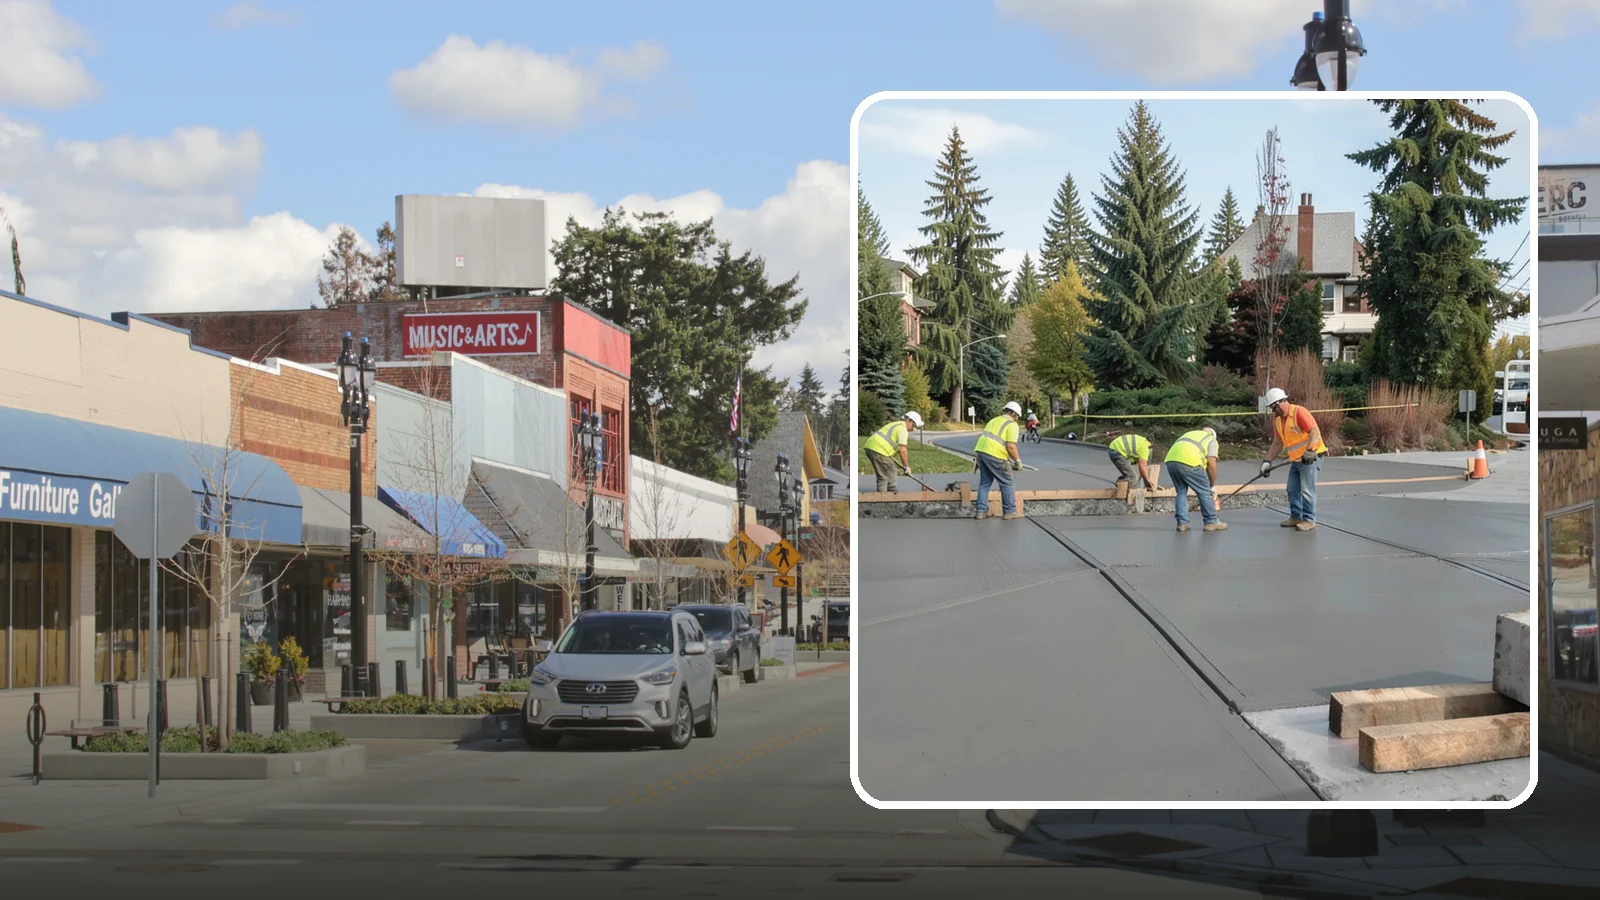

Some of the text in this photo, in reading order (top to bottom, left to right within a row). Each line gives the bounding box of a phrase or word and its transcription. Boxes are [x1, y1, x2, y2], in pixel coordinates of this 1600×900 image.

[0, 472, 121, 519] Furniture Gal
[453, 563, 479, 574] SUSHI
